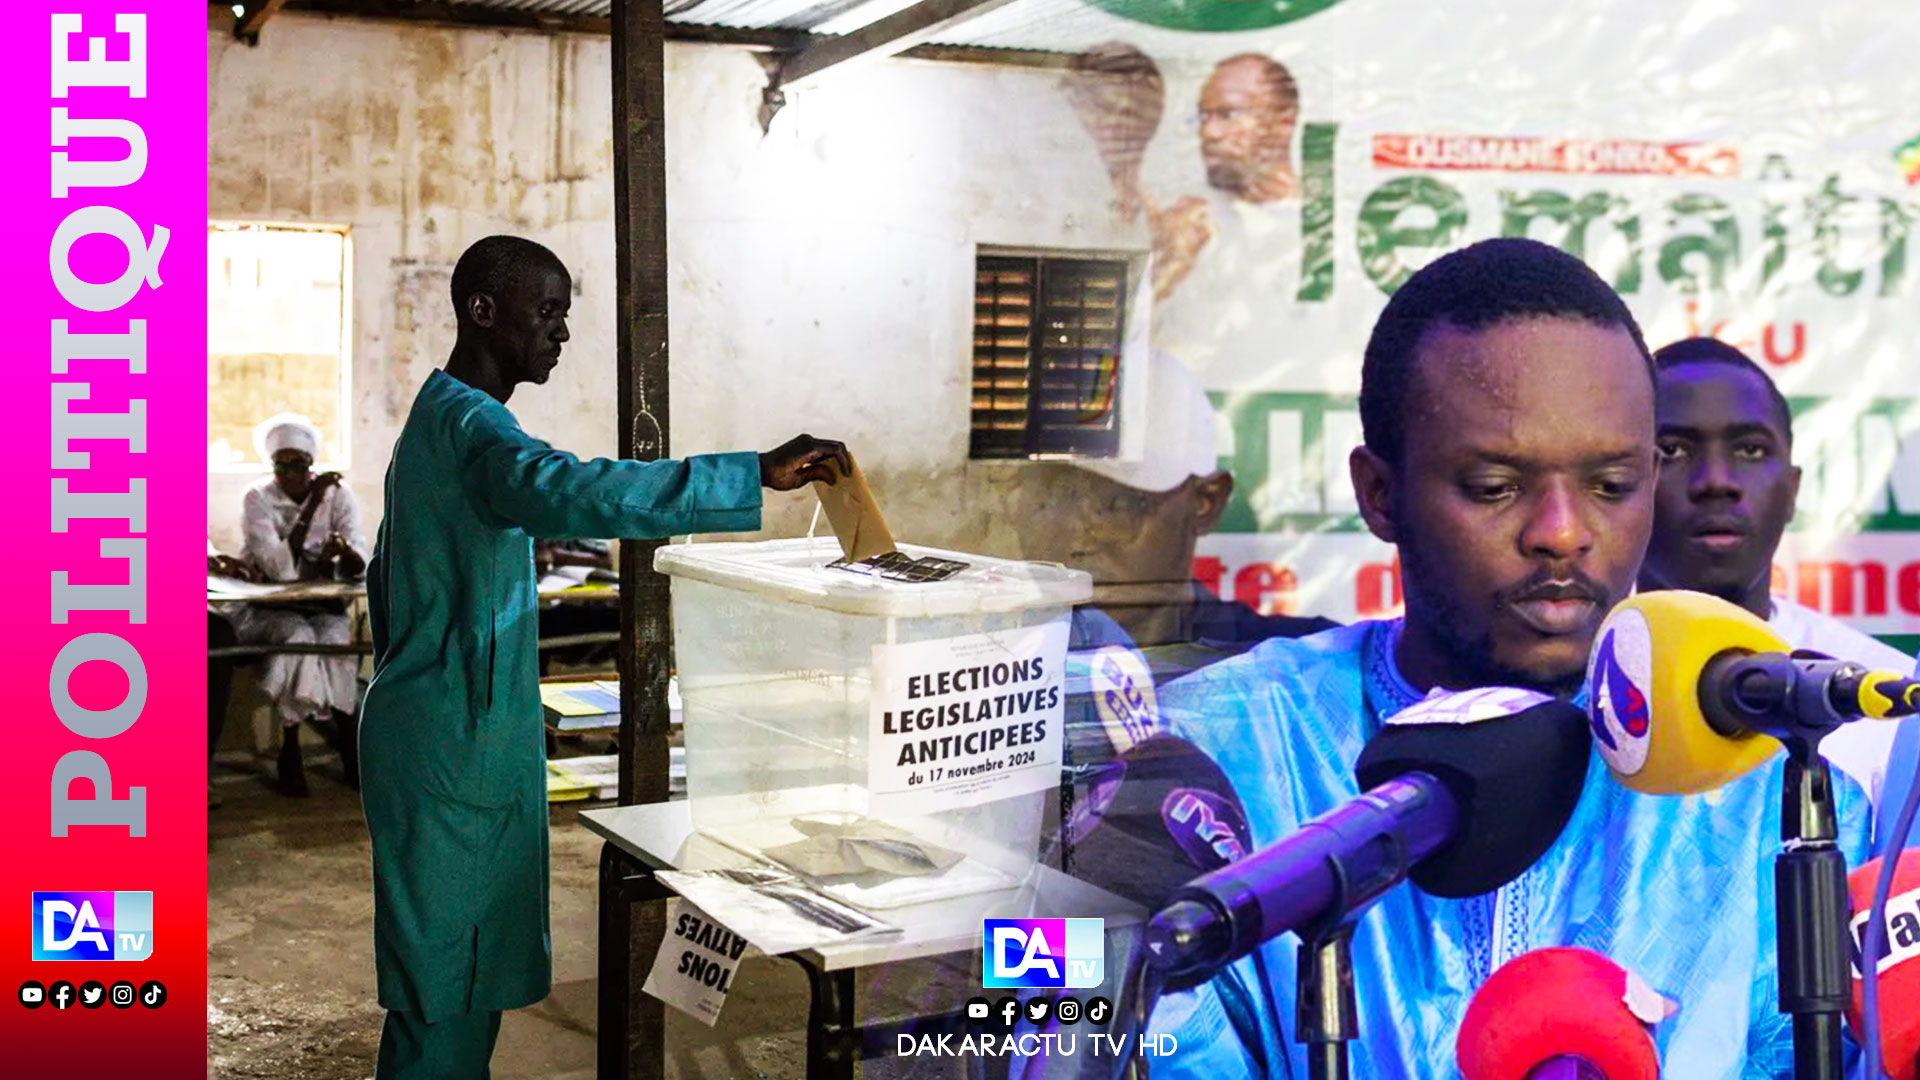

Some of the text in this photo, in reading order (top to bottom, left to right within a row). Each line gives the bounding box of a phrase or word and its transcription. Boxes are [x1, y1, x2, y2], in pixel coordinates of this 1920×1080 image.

[908, 657, 1043, 700] ELECTIONS
[883, 686, 1059, 735] LEGISLATIVES
[897, 720, 1046, 766] ANTICIPEES
[908, 772, 923, 786] du
[929, 768, 943, 782] 17
[947, 757, 1003, 779] novembre
[1008, 751, 1035, 768] 2024
[678, 950, 731, 994] IONS
